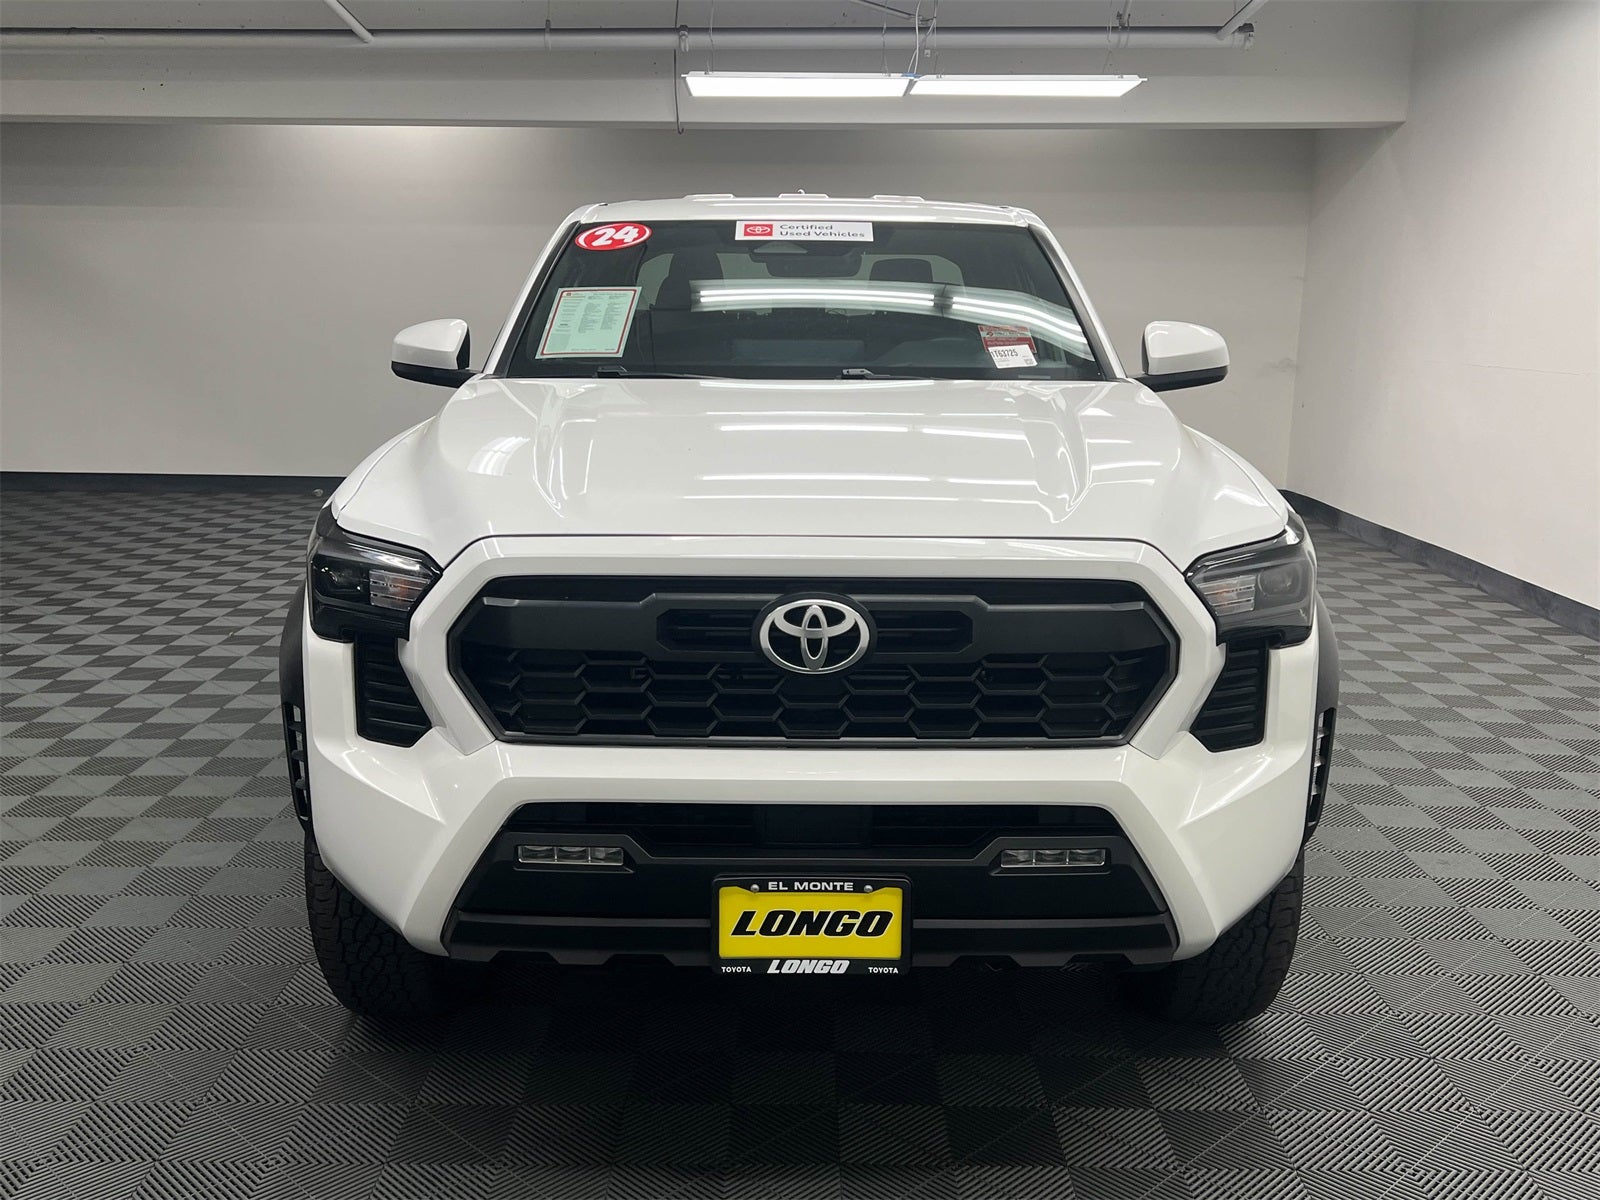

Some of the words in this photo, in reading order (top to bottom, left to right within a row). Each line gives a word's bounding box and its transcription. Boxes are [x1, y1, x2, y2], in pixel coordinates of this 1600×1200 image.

[779, 223, 833, 231] Certified
[591, 225, 639, 247] 24
[814, 230, 865, 238] Vehicles
[768, 881, 788, 891] EL
[794, 881, 854, 891] MONTE
[730, 909, 895, 938] LONGO
[766, 959, 850, 974] LONGO
[868, 966, 899, 974] TOYOTA
